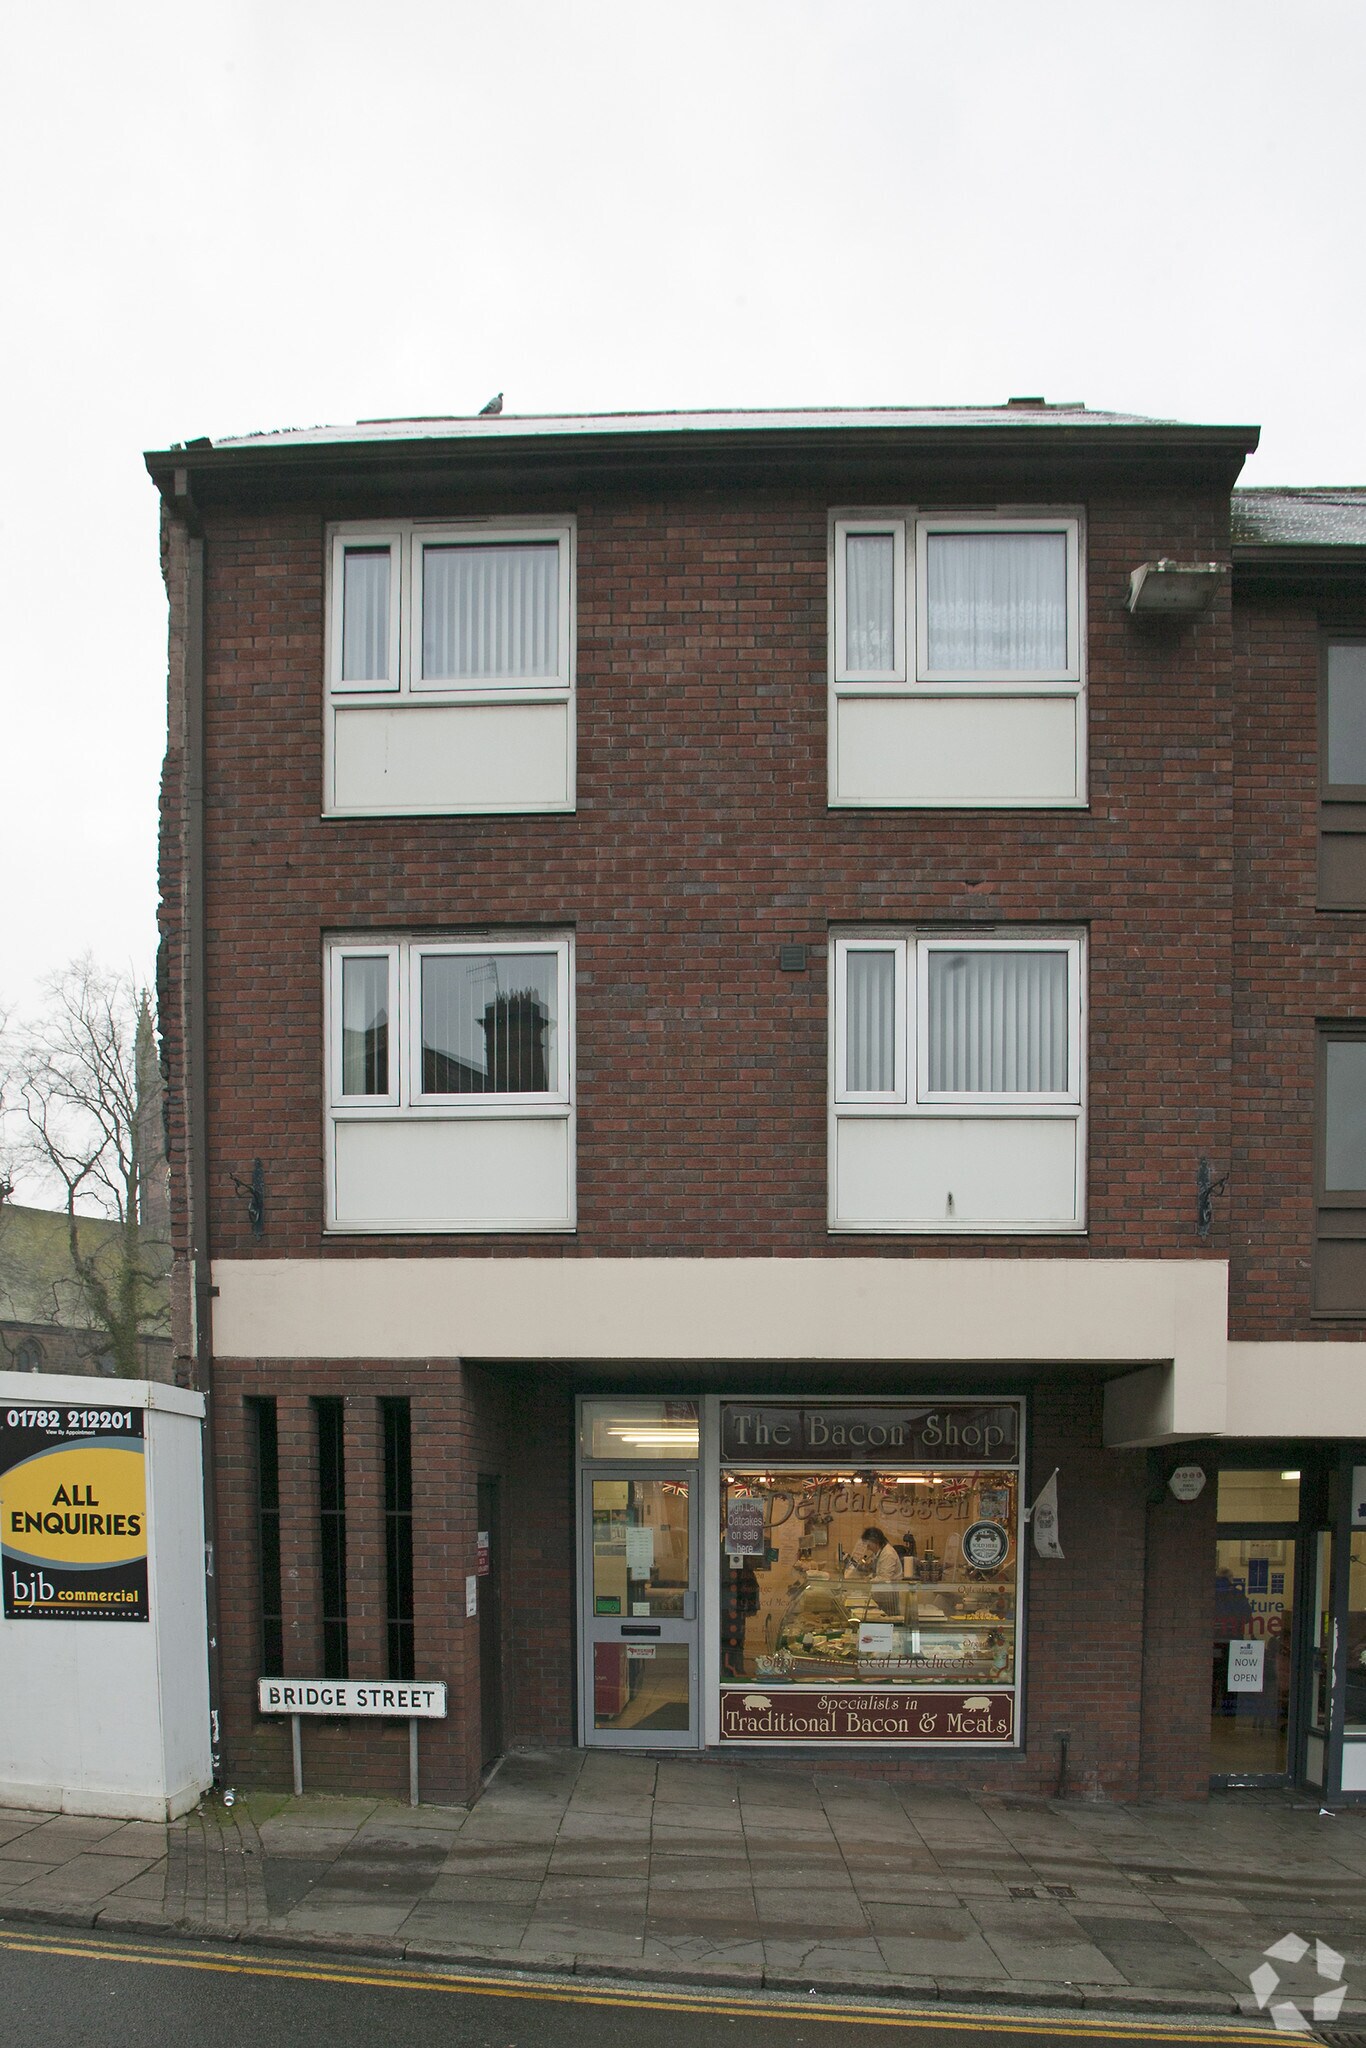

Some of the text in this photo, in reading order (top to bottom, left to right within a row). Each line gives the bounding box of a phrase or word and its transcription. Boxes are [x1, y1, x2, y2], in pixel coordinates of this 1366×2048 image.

[7, 1410, 132, 1429] 01782 212201
[733, 1413, 1005, 1456] The Bacon Shop
[52, 1483, 100, 1507] ALL
[762, 1484, 971, 1529] Delicatessen
[11, 1510, 142, 1537] ENQUIRIES
[728, 1514, 763, 1527] Oatcakes
[731, 1529, 759, 1541] on sale
[736, 1543, 754, 1554] here
[11, 1570, 139, 1608] bjb commercial
[896, 1654, 977, 1669] Producers
[1234, 1658, 1258, 1667] NOW
[1233, 1673, 1258, 1682] OPEN
[269, 1687, 435, 1708] BRIDGE STREET
[816, 1695, 918, 1714] Specialists in
[726, 1711, 1008, 1733] Traditional Bacon & Meats
